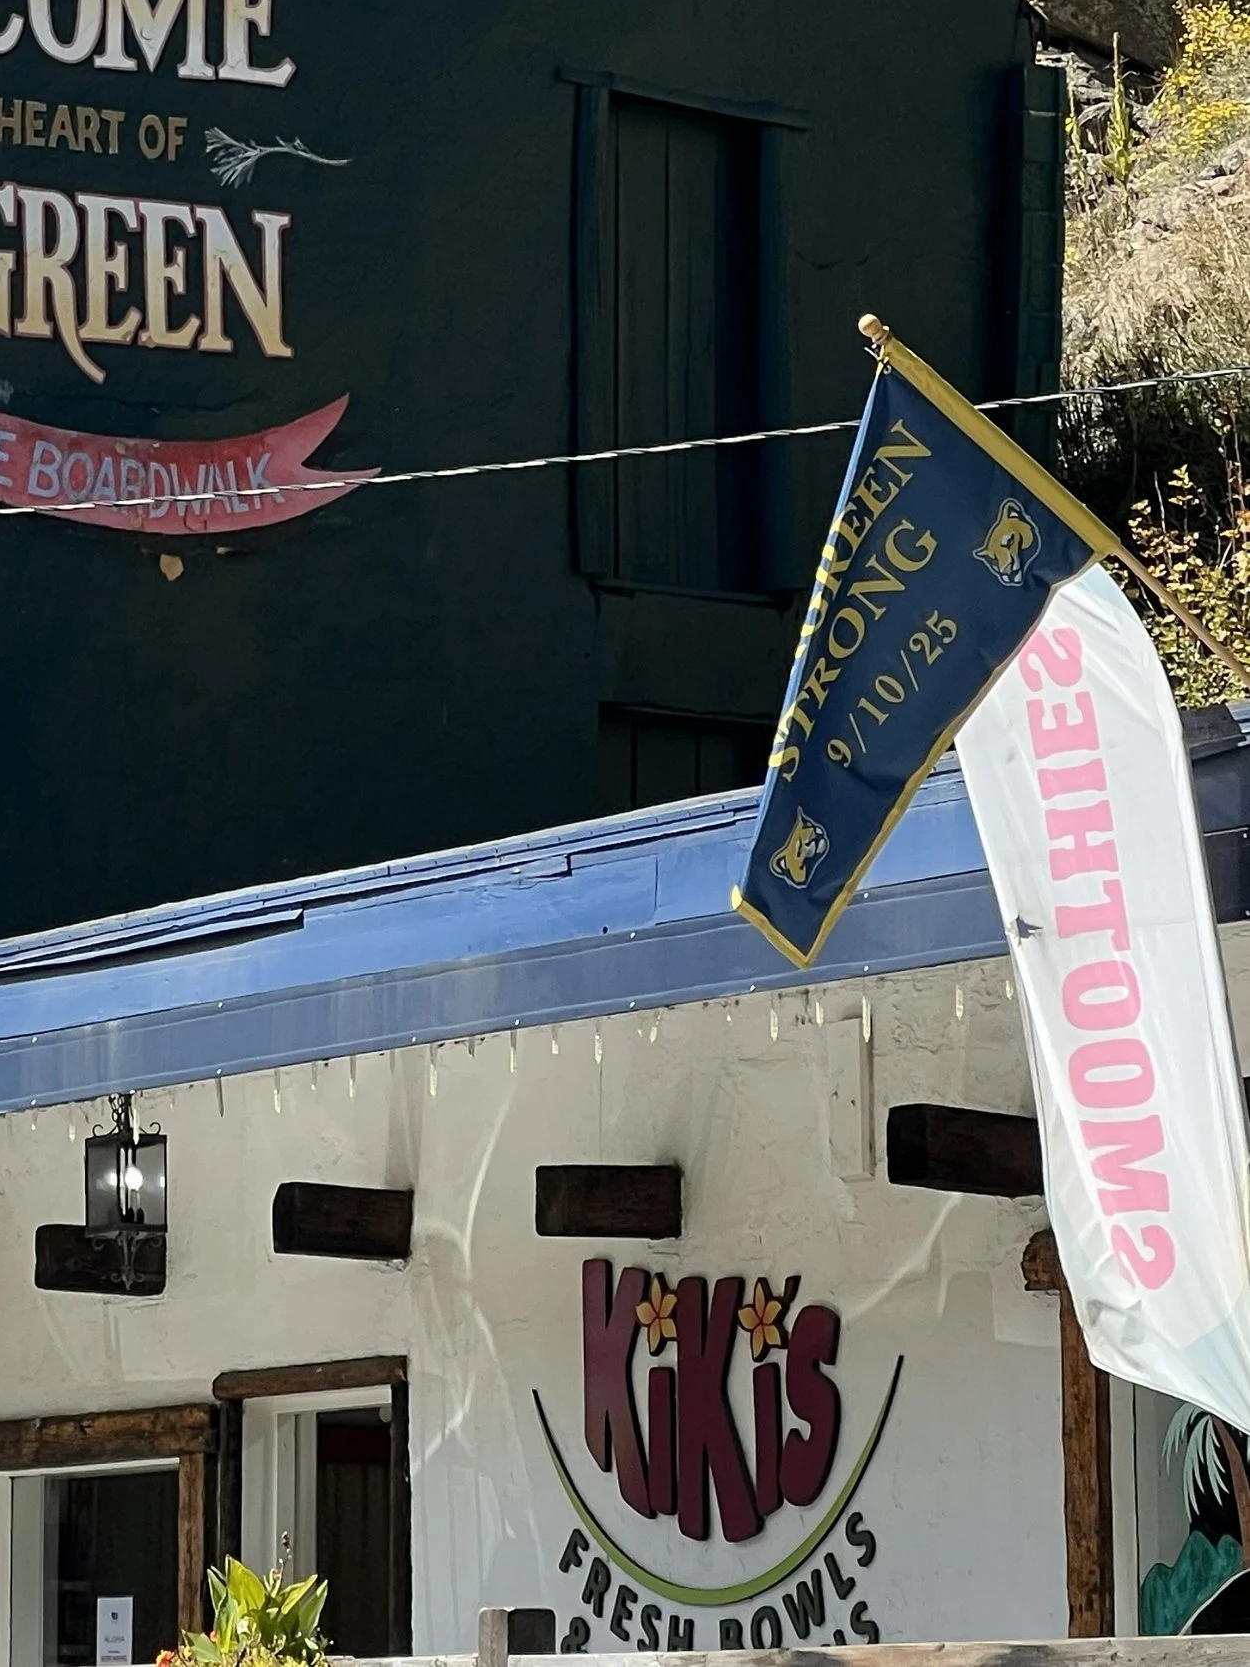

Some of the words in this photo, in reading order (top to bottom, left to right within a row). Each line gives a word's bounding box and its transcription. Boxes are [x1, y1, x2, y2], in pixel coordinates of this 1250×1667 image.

[138, 114, 188, 162] OF
[27, 439, 287, 520] BOARDWALK
[768, 519, 938, 783] STRONG
[827, 609, 958, 768] 9/10/25
[558, 1528, 695, 1652] FRESH
